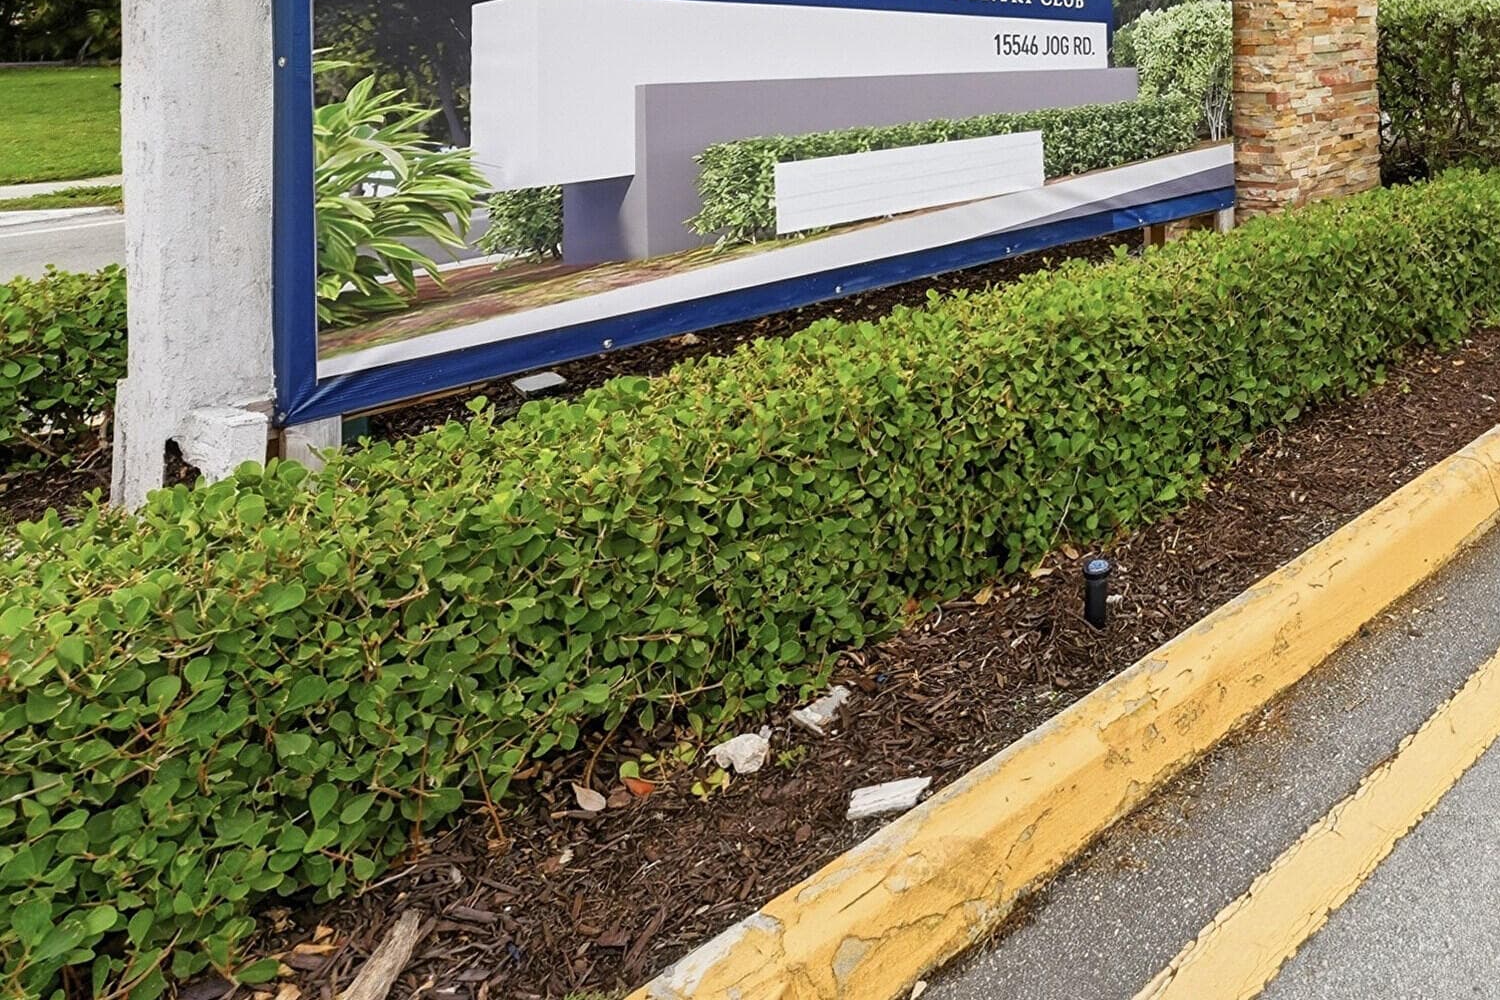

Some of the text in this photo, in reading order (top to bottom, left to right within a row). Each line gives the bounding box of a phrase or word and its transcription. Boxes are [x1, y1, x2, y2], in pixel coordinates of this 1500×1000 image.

[994, 33, 1096, 56] 15546 JOG RD.
